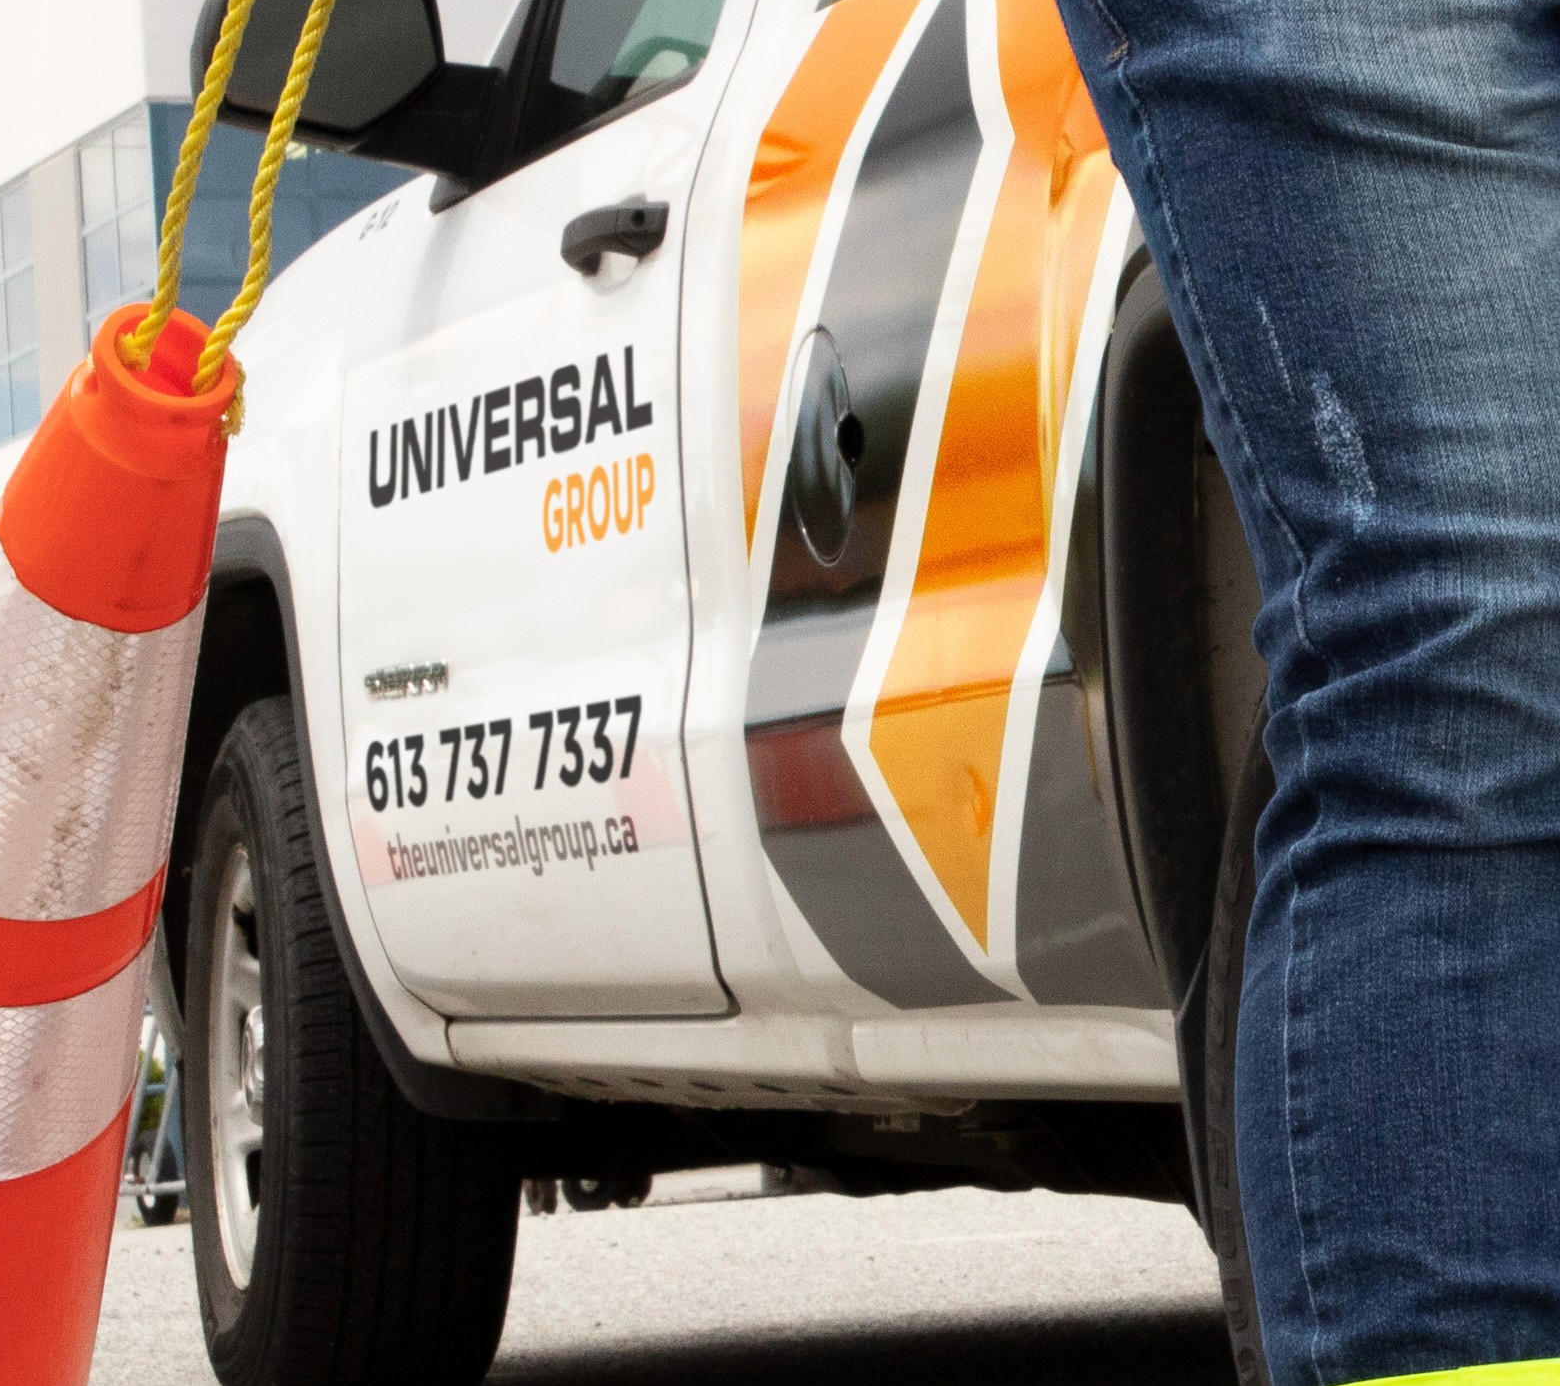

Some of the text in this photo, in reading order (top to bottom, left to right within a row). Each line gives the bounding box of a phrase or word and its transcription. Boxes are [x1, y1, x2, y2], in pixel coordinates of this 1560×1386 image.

[368, 344, 653, 508] UNIVERSAL
[542, 453, 655, 553] GROUP
[365, 695, 642, 813] 613 737 7337
[387, 814, 640, 882] theuniversalgroup.ca
